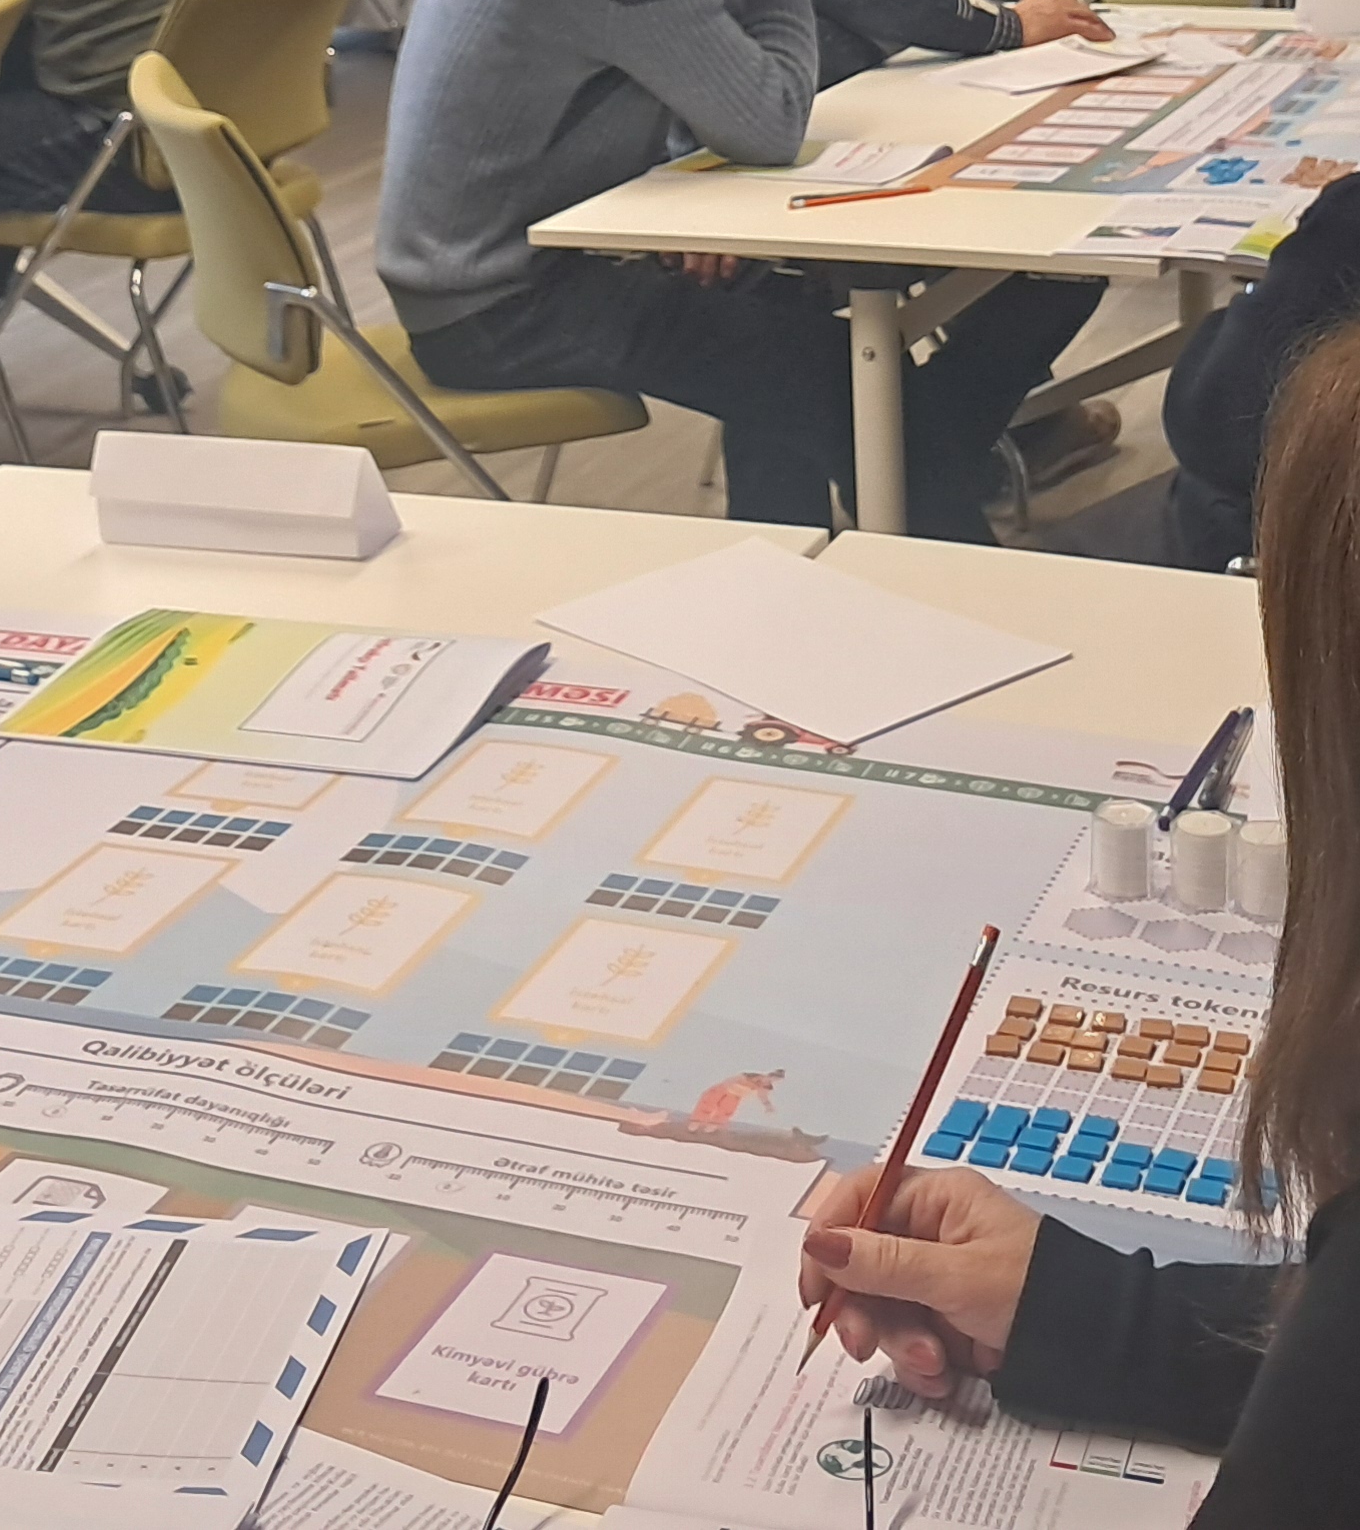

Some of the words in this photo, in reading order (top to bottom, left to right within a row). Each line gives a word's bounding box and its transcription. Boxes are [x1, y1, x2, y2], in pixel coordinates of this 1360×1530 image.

[1060, 975, 1160, 1004] Resurs
[82, 1039, 231, 1072] Qalibiyyət
[234, 1059, 353, 1101] ölçüləri
[87, 1079, 182, 1102] Təsərrüfat
[183, 1094, 291, 1129] dayanıqlığı
[493, 1157, 550, 1178] Ətraf
[551, 1164, 626, 1190] mühitə
[630, 1180, 678, 1200] təsir
[431, 1344, 516, 1372] Kimyəvi
[515, 1363, 580, 1385] gübrə
[467, 1370, 518, 1392] kartı
